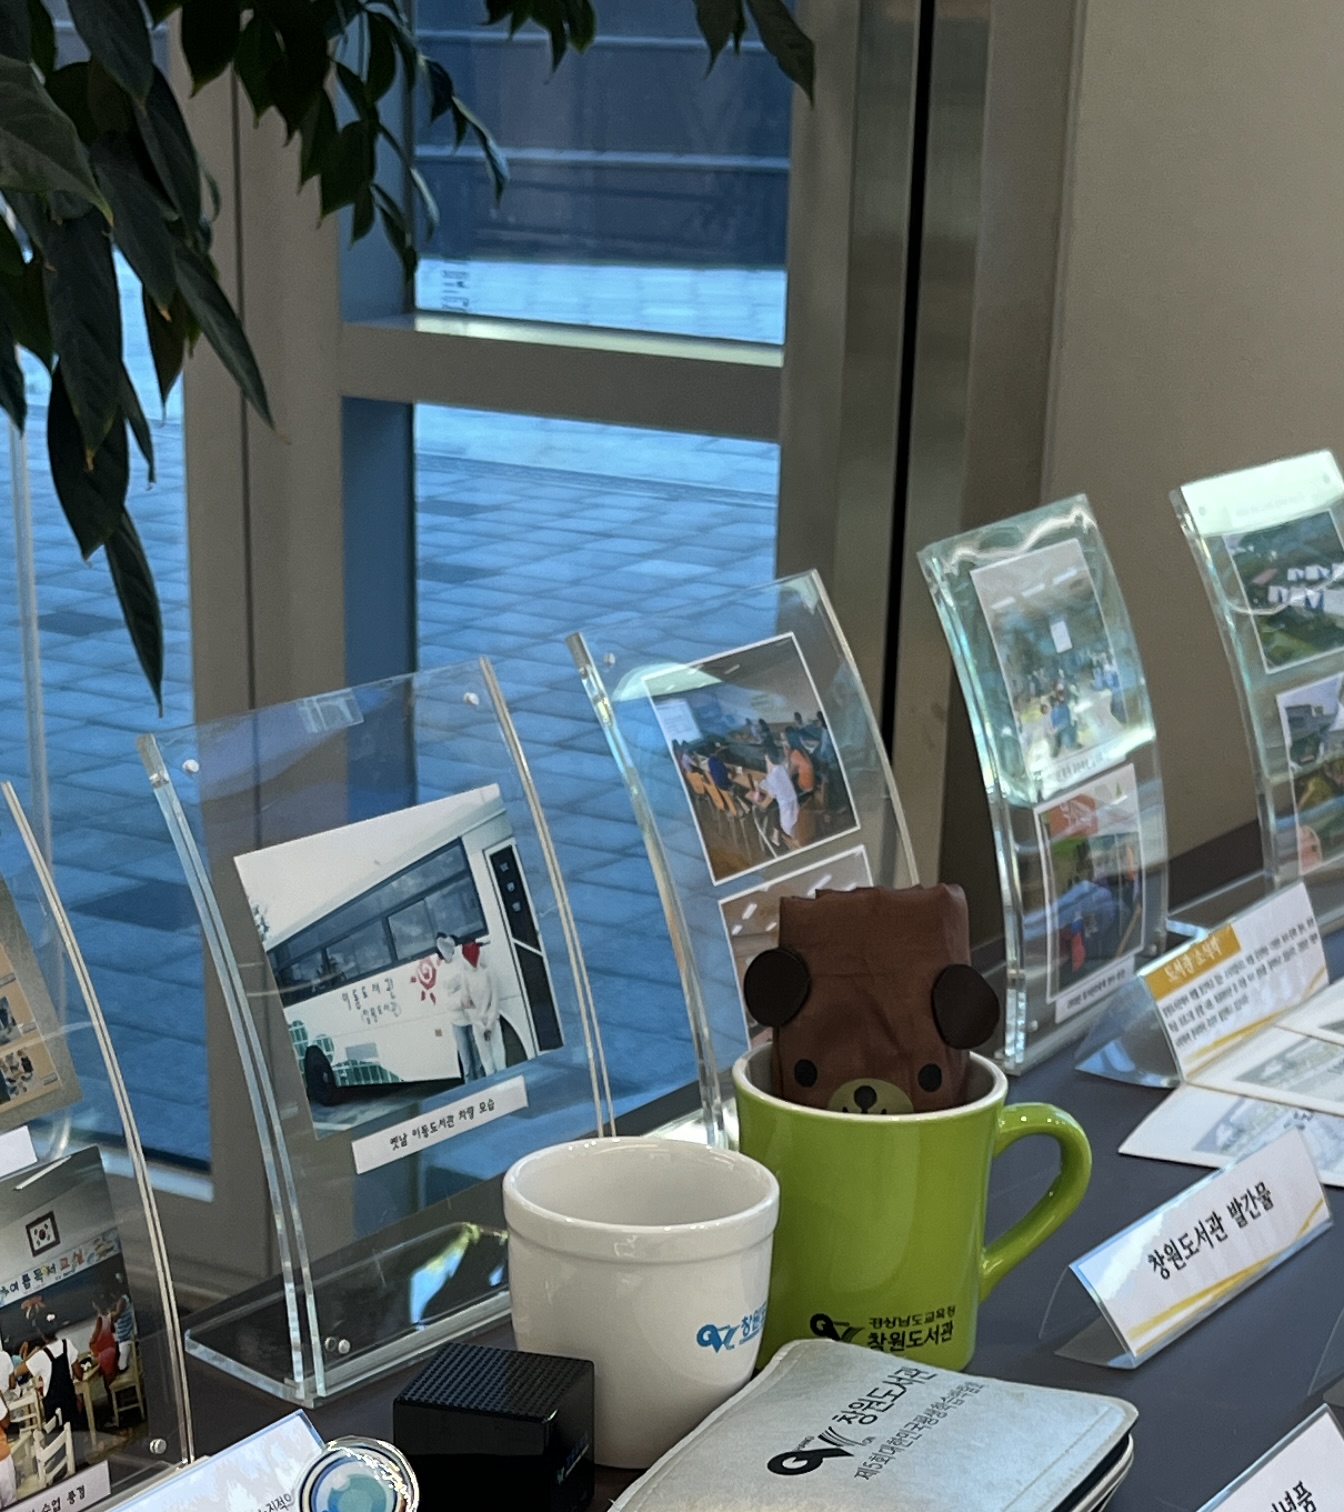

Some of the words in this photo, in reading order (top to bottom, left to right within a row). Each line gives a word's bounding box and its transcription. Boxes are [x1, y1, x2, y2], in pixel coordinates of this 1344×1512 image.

[411, 1112, 456, 1142] 이동도서관
[478, 1097, 496, 1116] 모습
[1146, 1213, 1229, 1282] 창원도서관
[1226, 1180, 1276, 1236] 발간물
[866, 1320, 955, 1353] 창원도서관
[831, 1366, 938, 1425] 창원도서관
